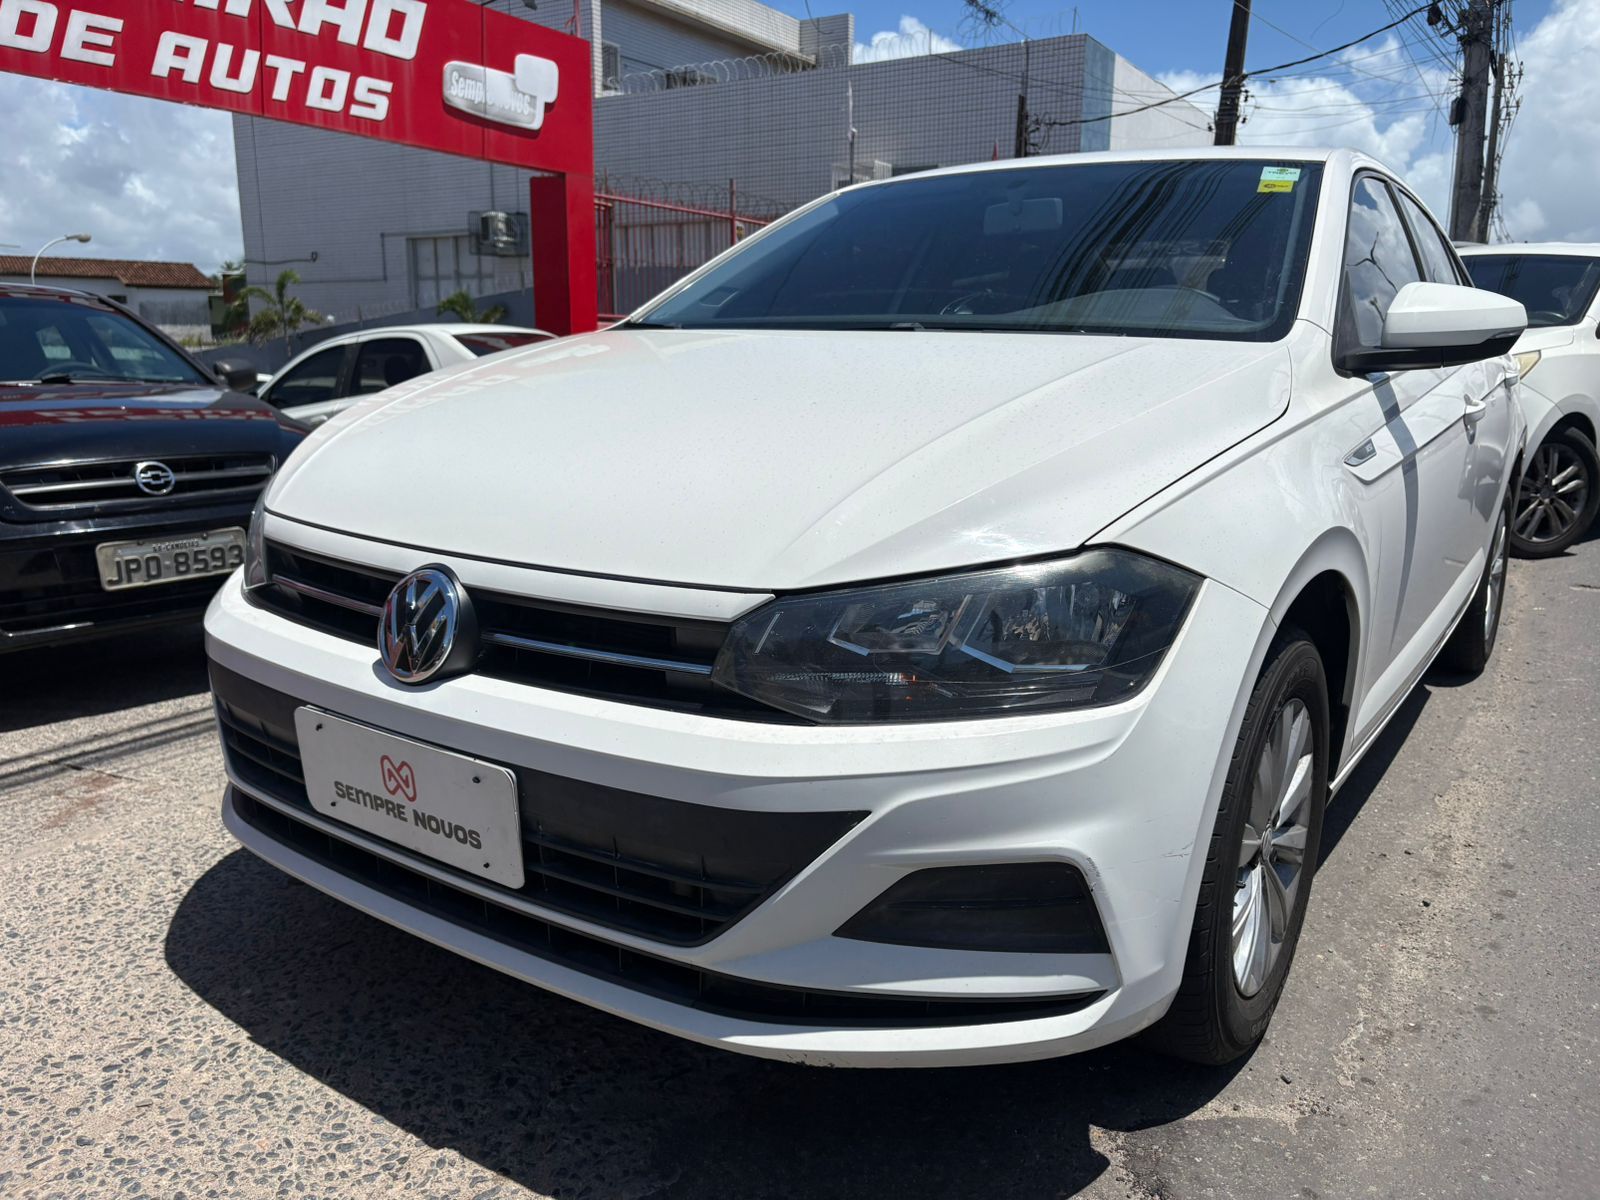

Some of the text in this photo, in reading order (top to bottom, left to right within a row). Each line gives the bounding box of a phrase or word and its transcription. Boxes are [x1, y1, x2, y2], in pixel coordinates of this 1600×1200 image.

[0, 0, 124, 67] DE
[151, 30, 393, 121] AUTOS
[451, 70, 495, 106] Semp
[333, 780, 409, 824] SEMPRE
